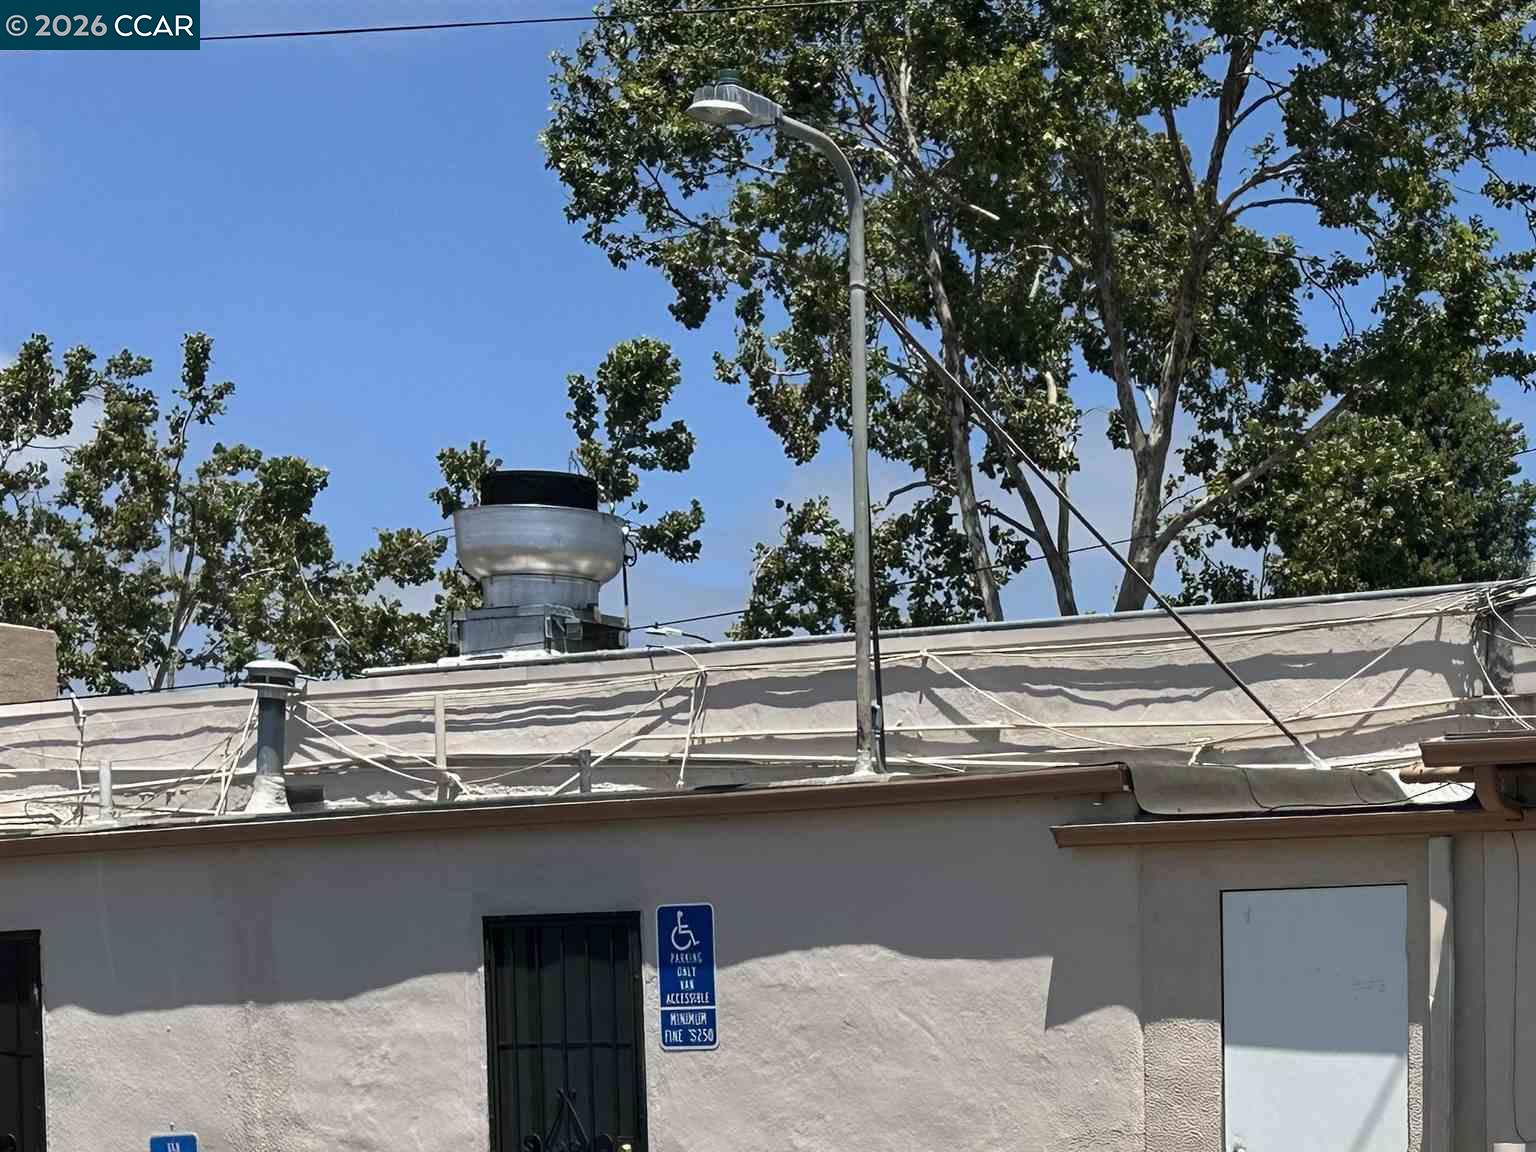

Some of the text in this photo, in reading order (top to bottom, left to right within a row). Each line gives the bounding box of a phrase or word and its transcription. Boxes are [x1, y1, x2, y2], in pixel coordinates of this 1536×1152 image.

[670, 952, 703, 963] PARKING
[677, 966, 697, 977] ONLY
[680, 979, 695, 990] VAN
[666, 992, 709, 1004] ACCESSIBLE
[670, 1012, 707, 1025] MINIMUM
[664, 1029, 683, 1042] FINE
